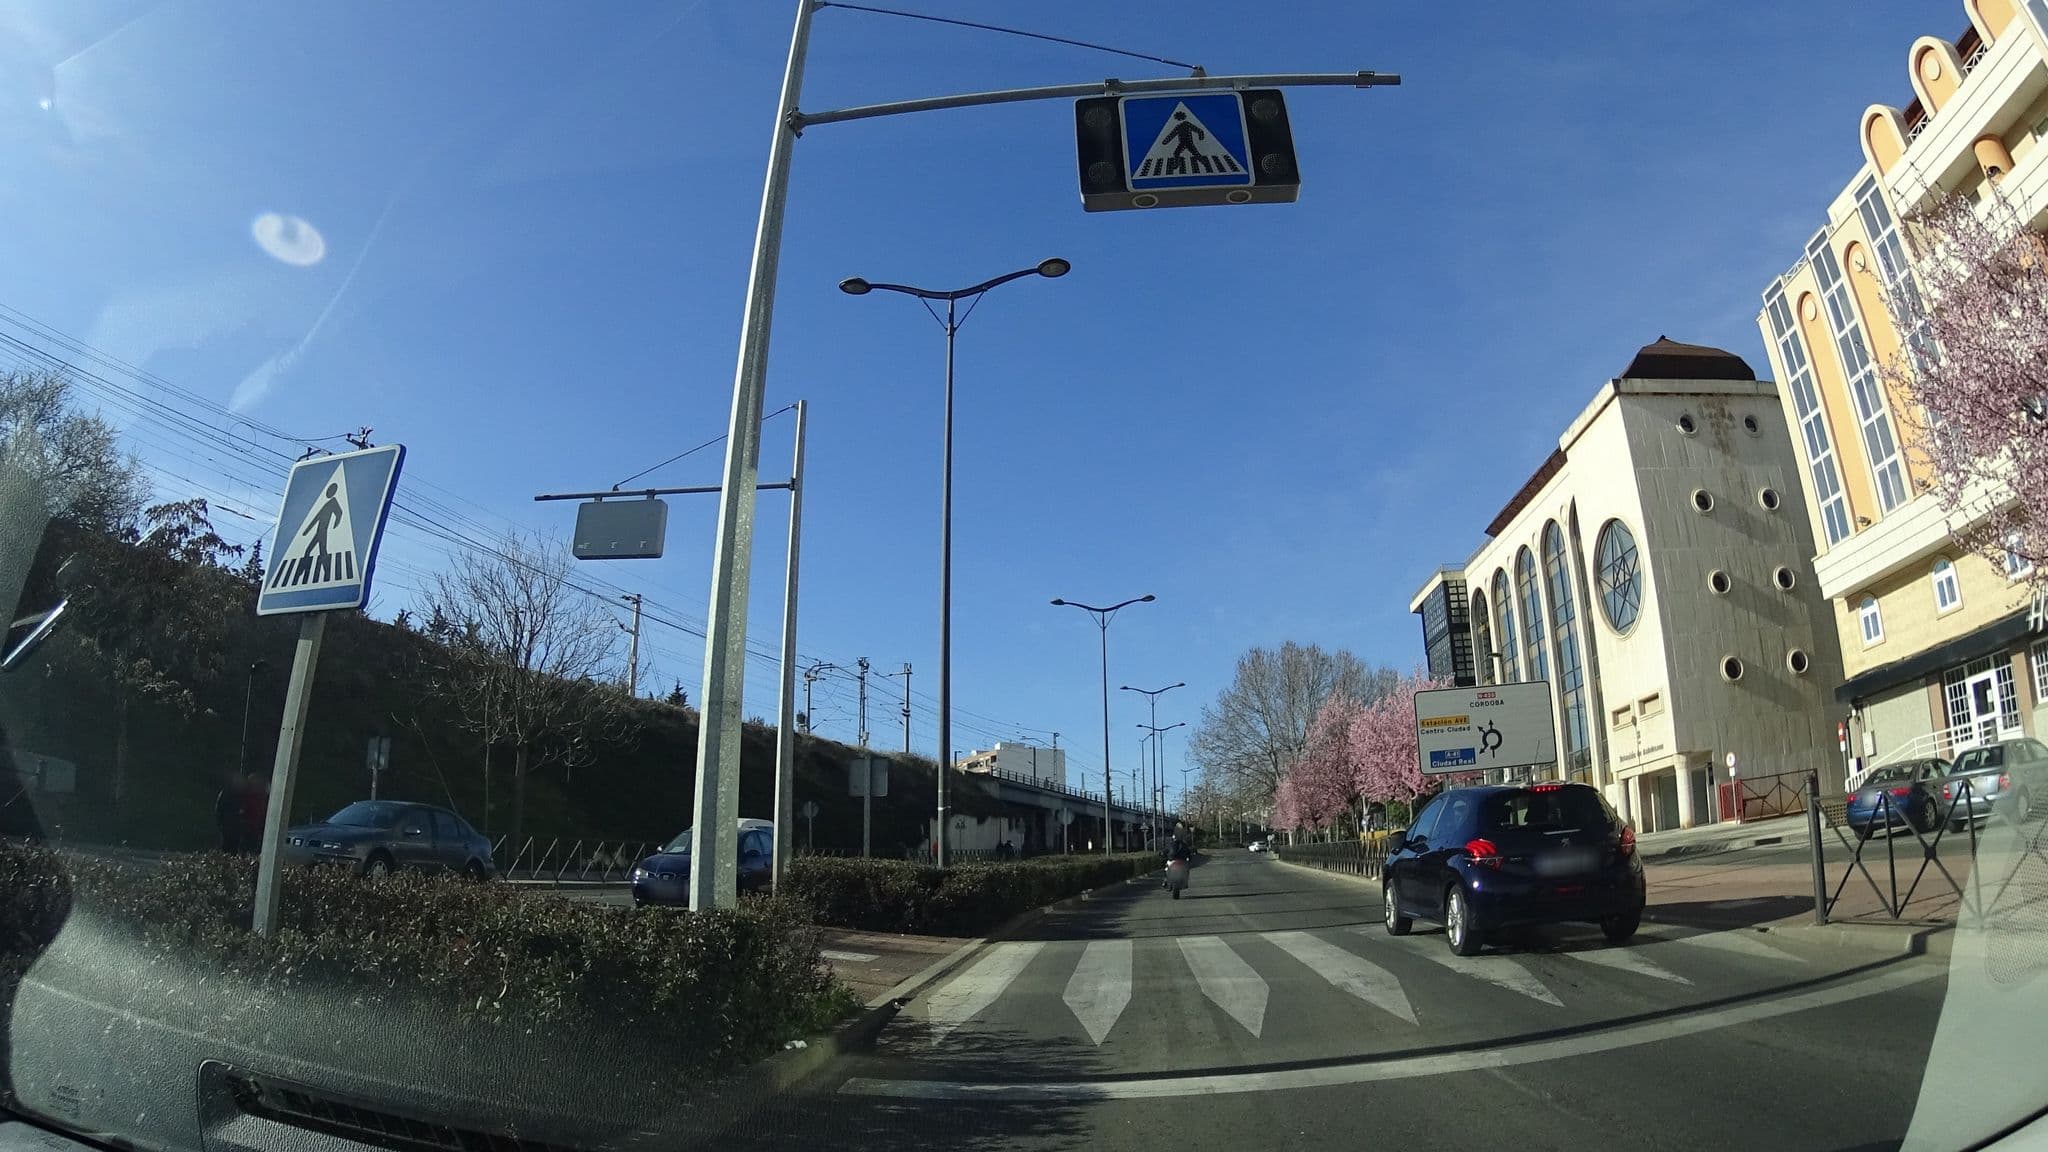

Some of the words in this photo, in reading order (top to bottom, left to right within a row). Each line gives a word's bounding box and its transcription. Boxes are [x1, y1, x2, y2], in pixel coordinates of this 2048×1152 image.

[1454, 716, 1467, 724] AVE
[1447, 725, 1471, 733] Ciudad
[1431, 759, 1457, 768] Ciudad
[1458, 758, 1475, 766] Real
